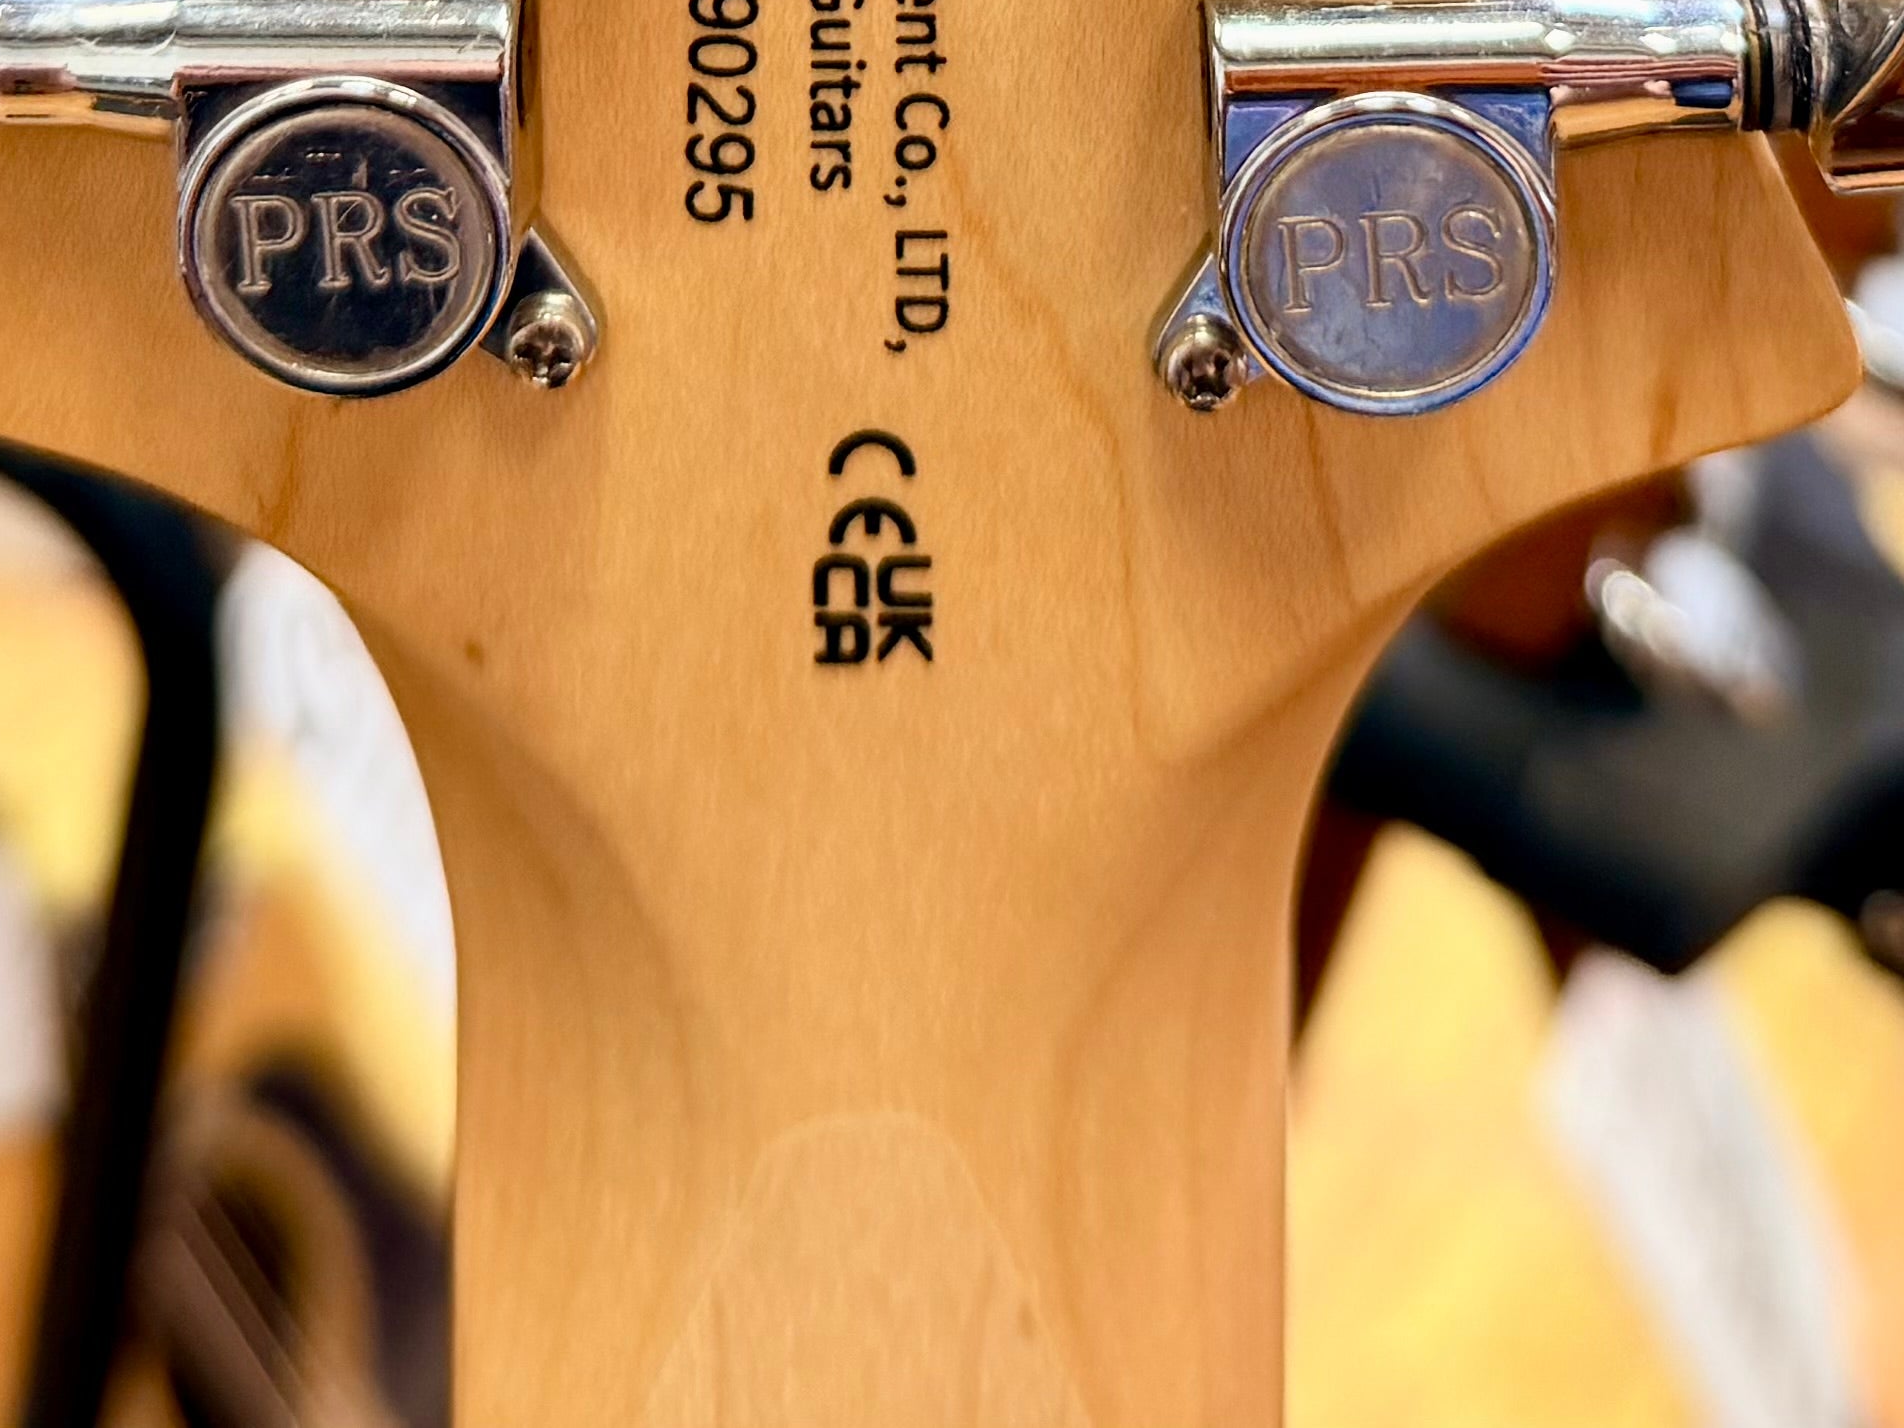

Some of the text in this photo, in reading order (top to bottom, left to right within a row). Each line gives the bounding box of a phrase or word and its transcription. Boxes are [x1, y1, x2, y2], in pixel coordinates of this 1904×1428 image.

[883, 93, 951, 208] Co.,
[232, 186, 464, 294] PRS
[884, 230, 950, 354] LTD,
[1274, 206, 1508, 316] PRS
[828, 430, 917, 547] CE
[812, 553, 871, 667] CA
[875, 555, 933, 663] UK
